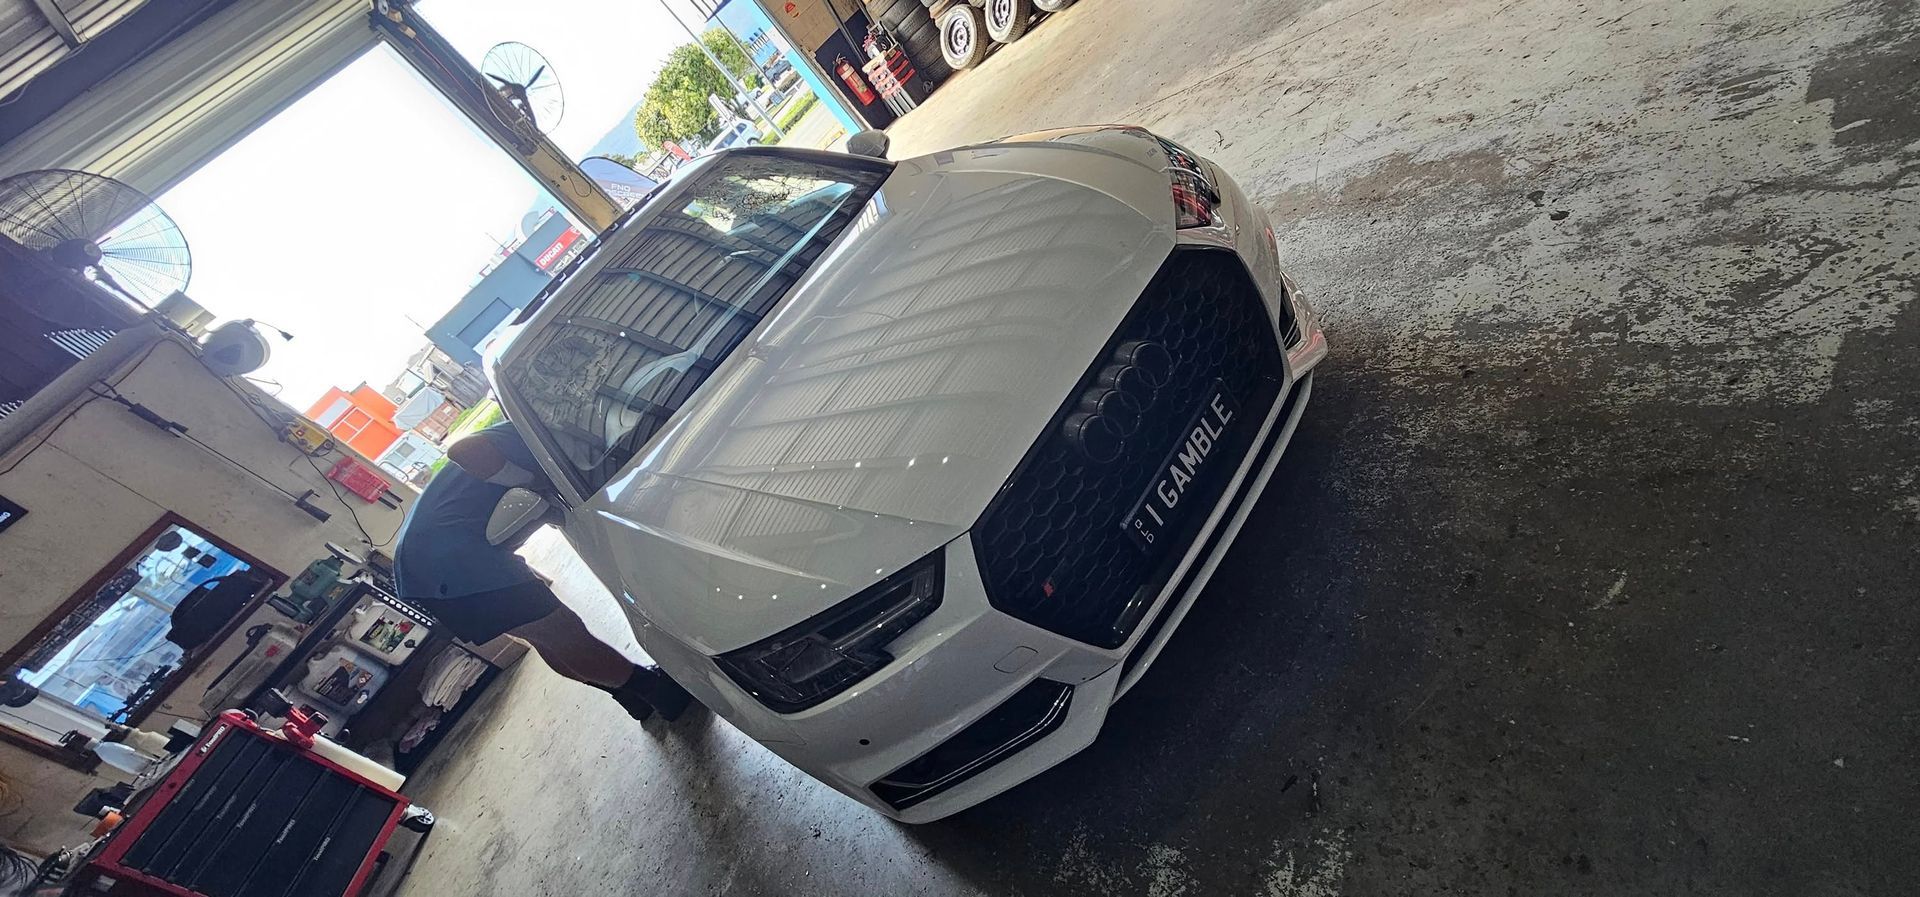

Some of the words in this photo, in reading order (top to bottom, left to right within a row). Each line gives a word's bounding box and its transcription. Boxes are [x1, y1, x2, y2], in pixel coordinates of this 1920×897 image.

[611, 183, 631, 192] FNQ
[539, 242, 564, 266] DUCATI
[1157, 393, 1233, 509] GAMBLE
[1134, 519, 1155, 544] QLD
